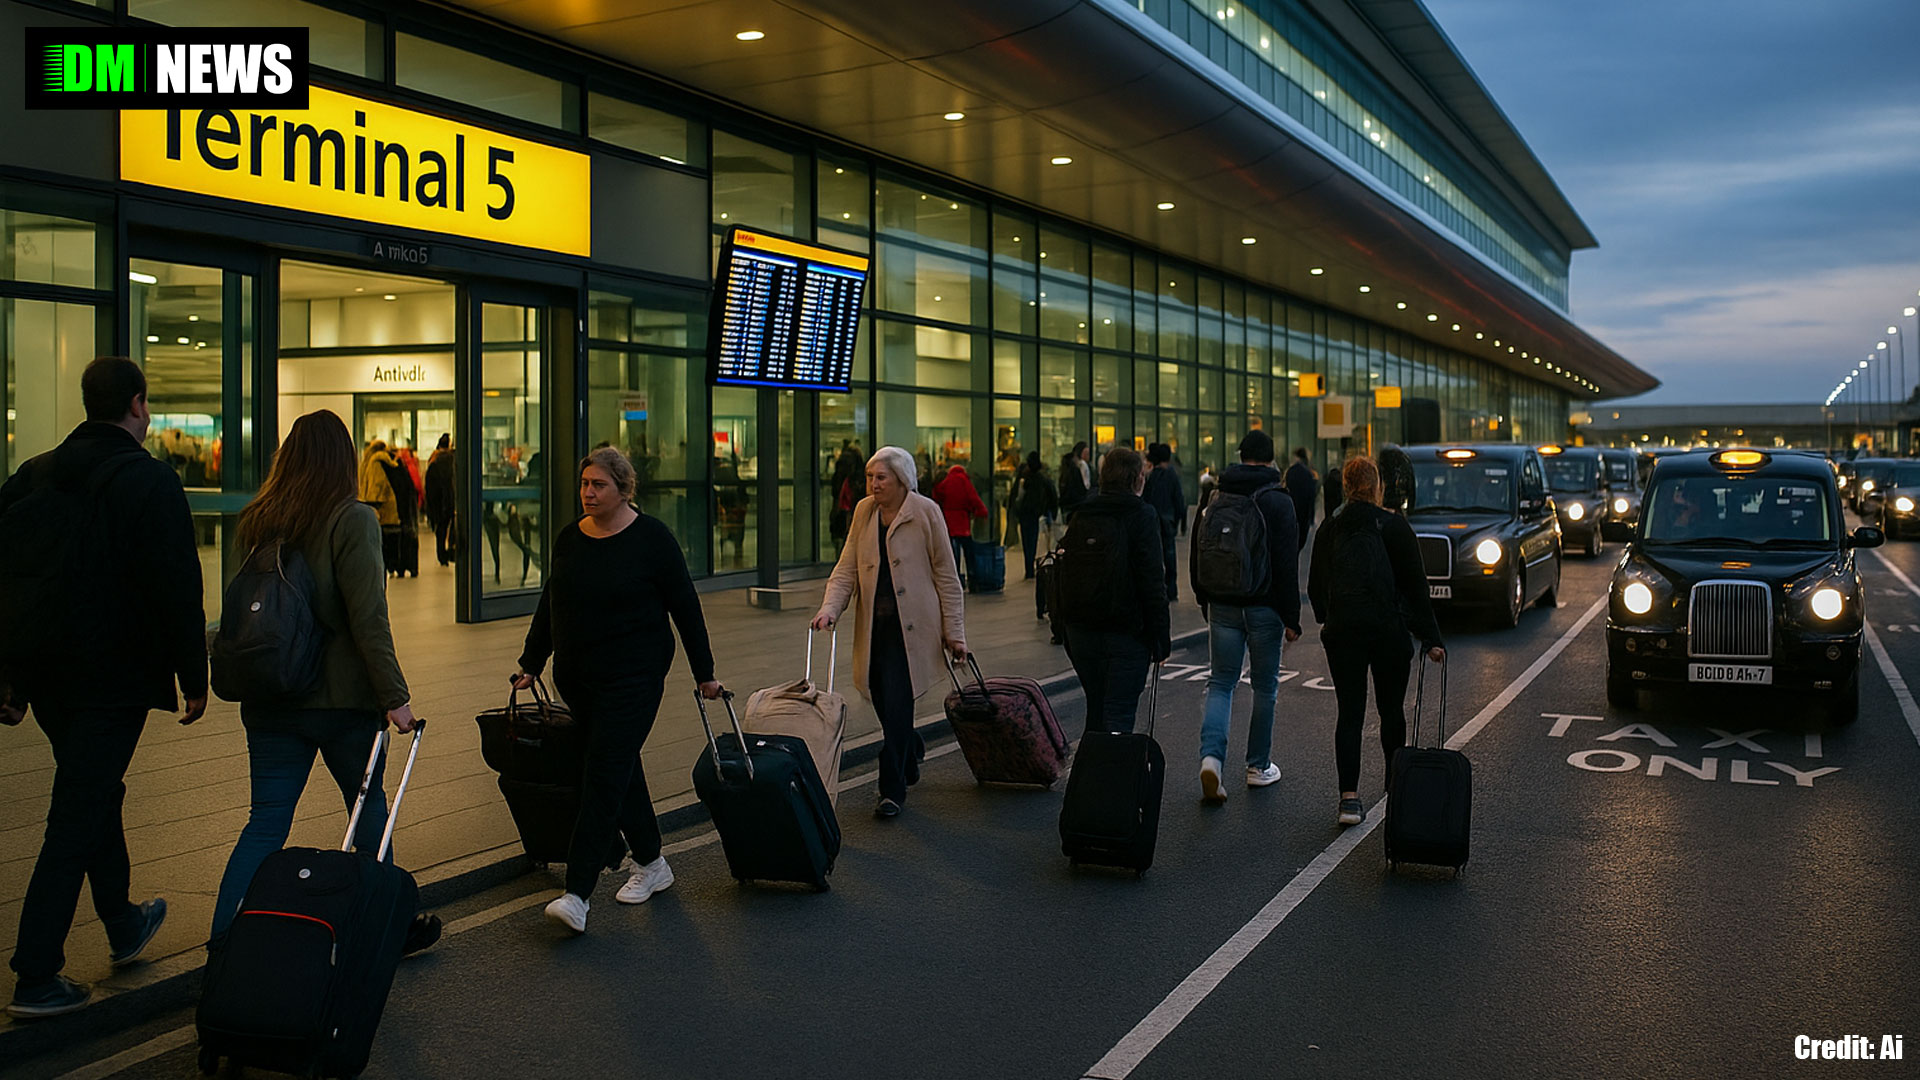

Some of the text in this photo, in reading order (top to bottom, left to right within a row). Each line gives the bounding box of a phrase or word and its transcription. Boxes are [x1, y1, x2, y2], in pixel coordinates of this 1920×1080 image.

[486, 148, 515, 220] 5
[1540, 712, 1824, 758] TAXI
[1566, 748, 1842, 788] ONLY
